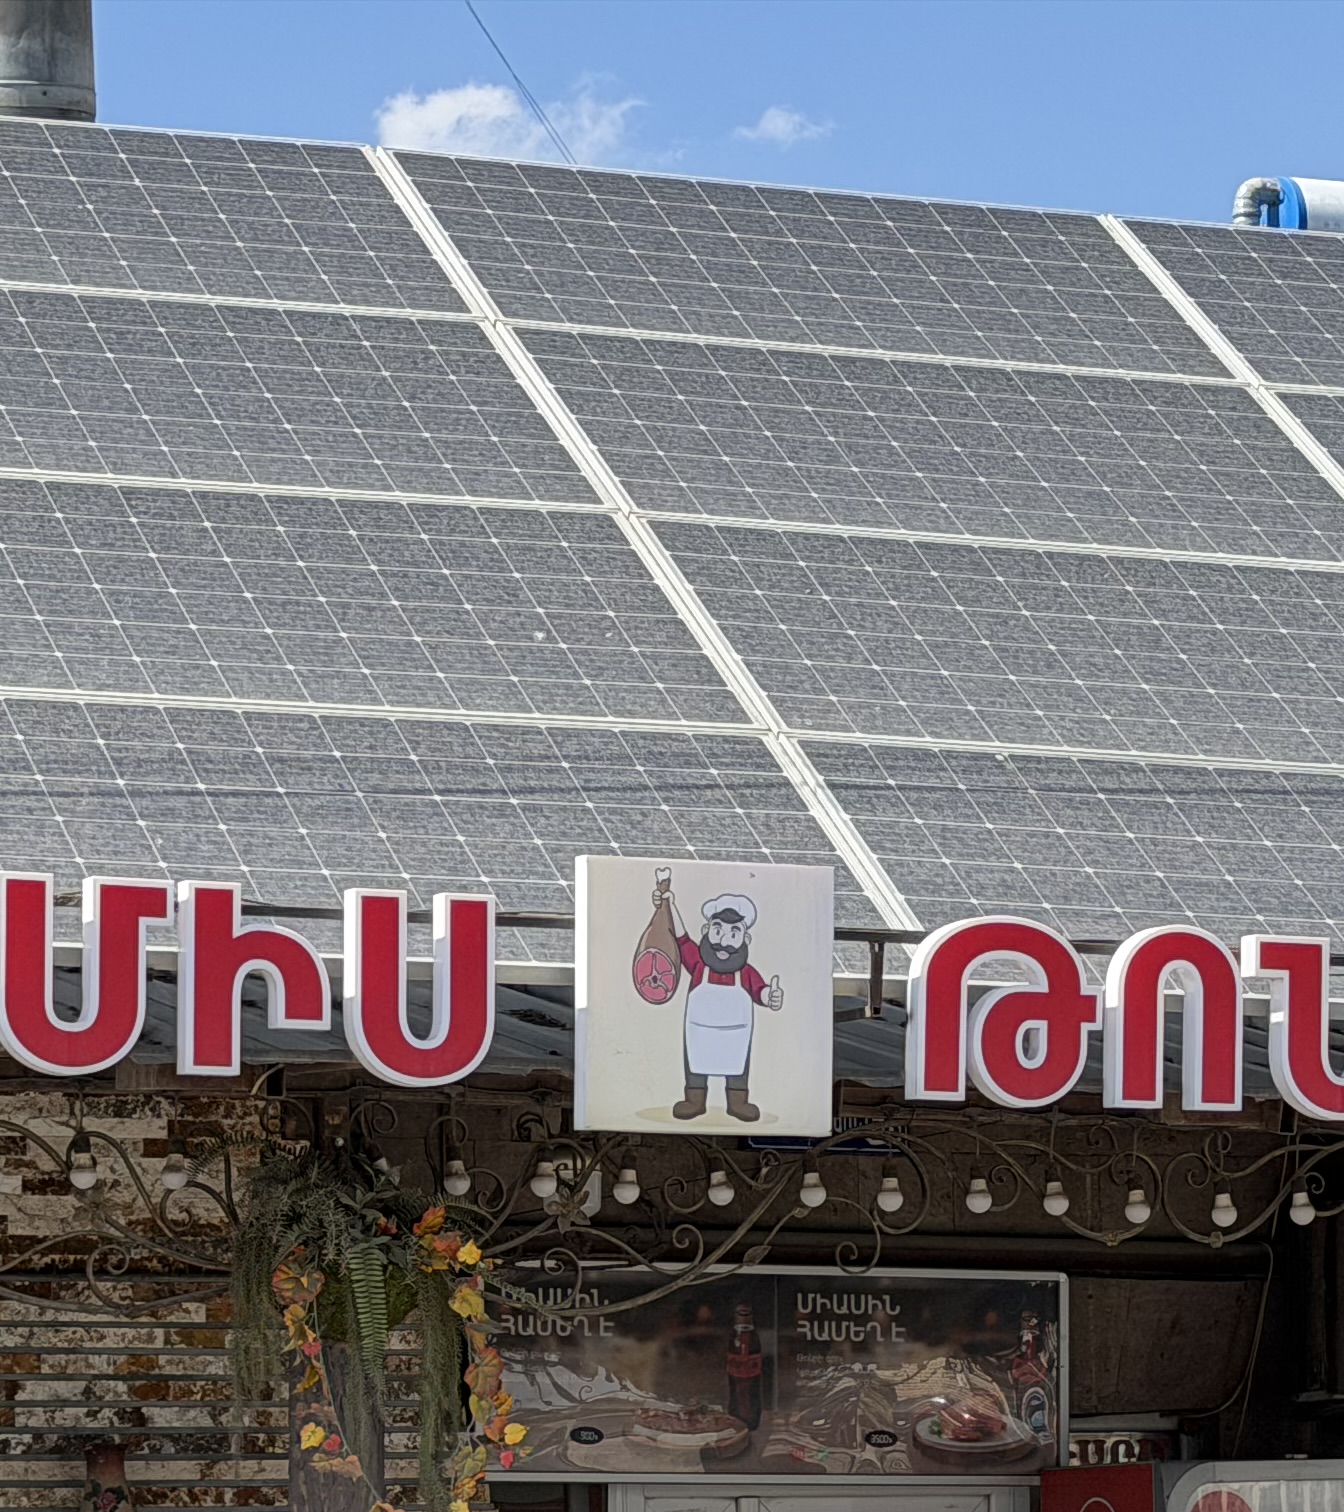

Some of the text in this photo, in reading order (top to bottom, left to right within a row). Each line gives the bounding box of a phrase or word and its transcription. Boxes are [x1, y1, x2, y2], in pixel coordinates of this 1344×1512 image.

[796, 1292, 901, 1316] ՄԻԱՍԻՆ
[796, 1320, 907, 1343] ՀԱՄԵՂ Է
